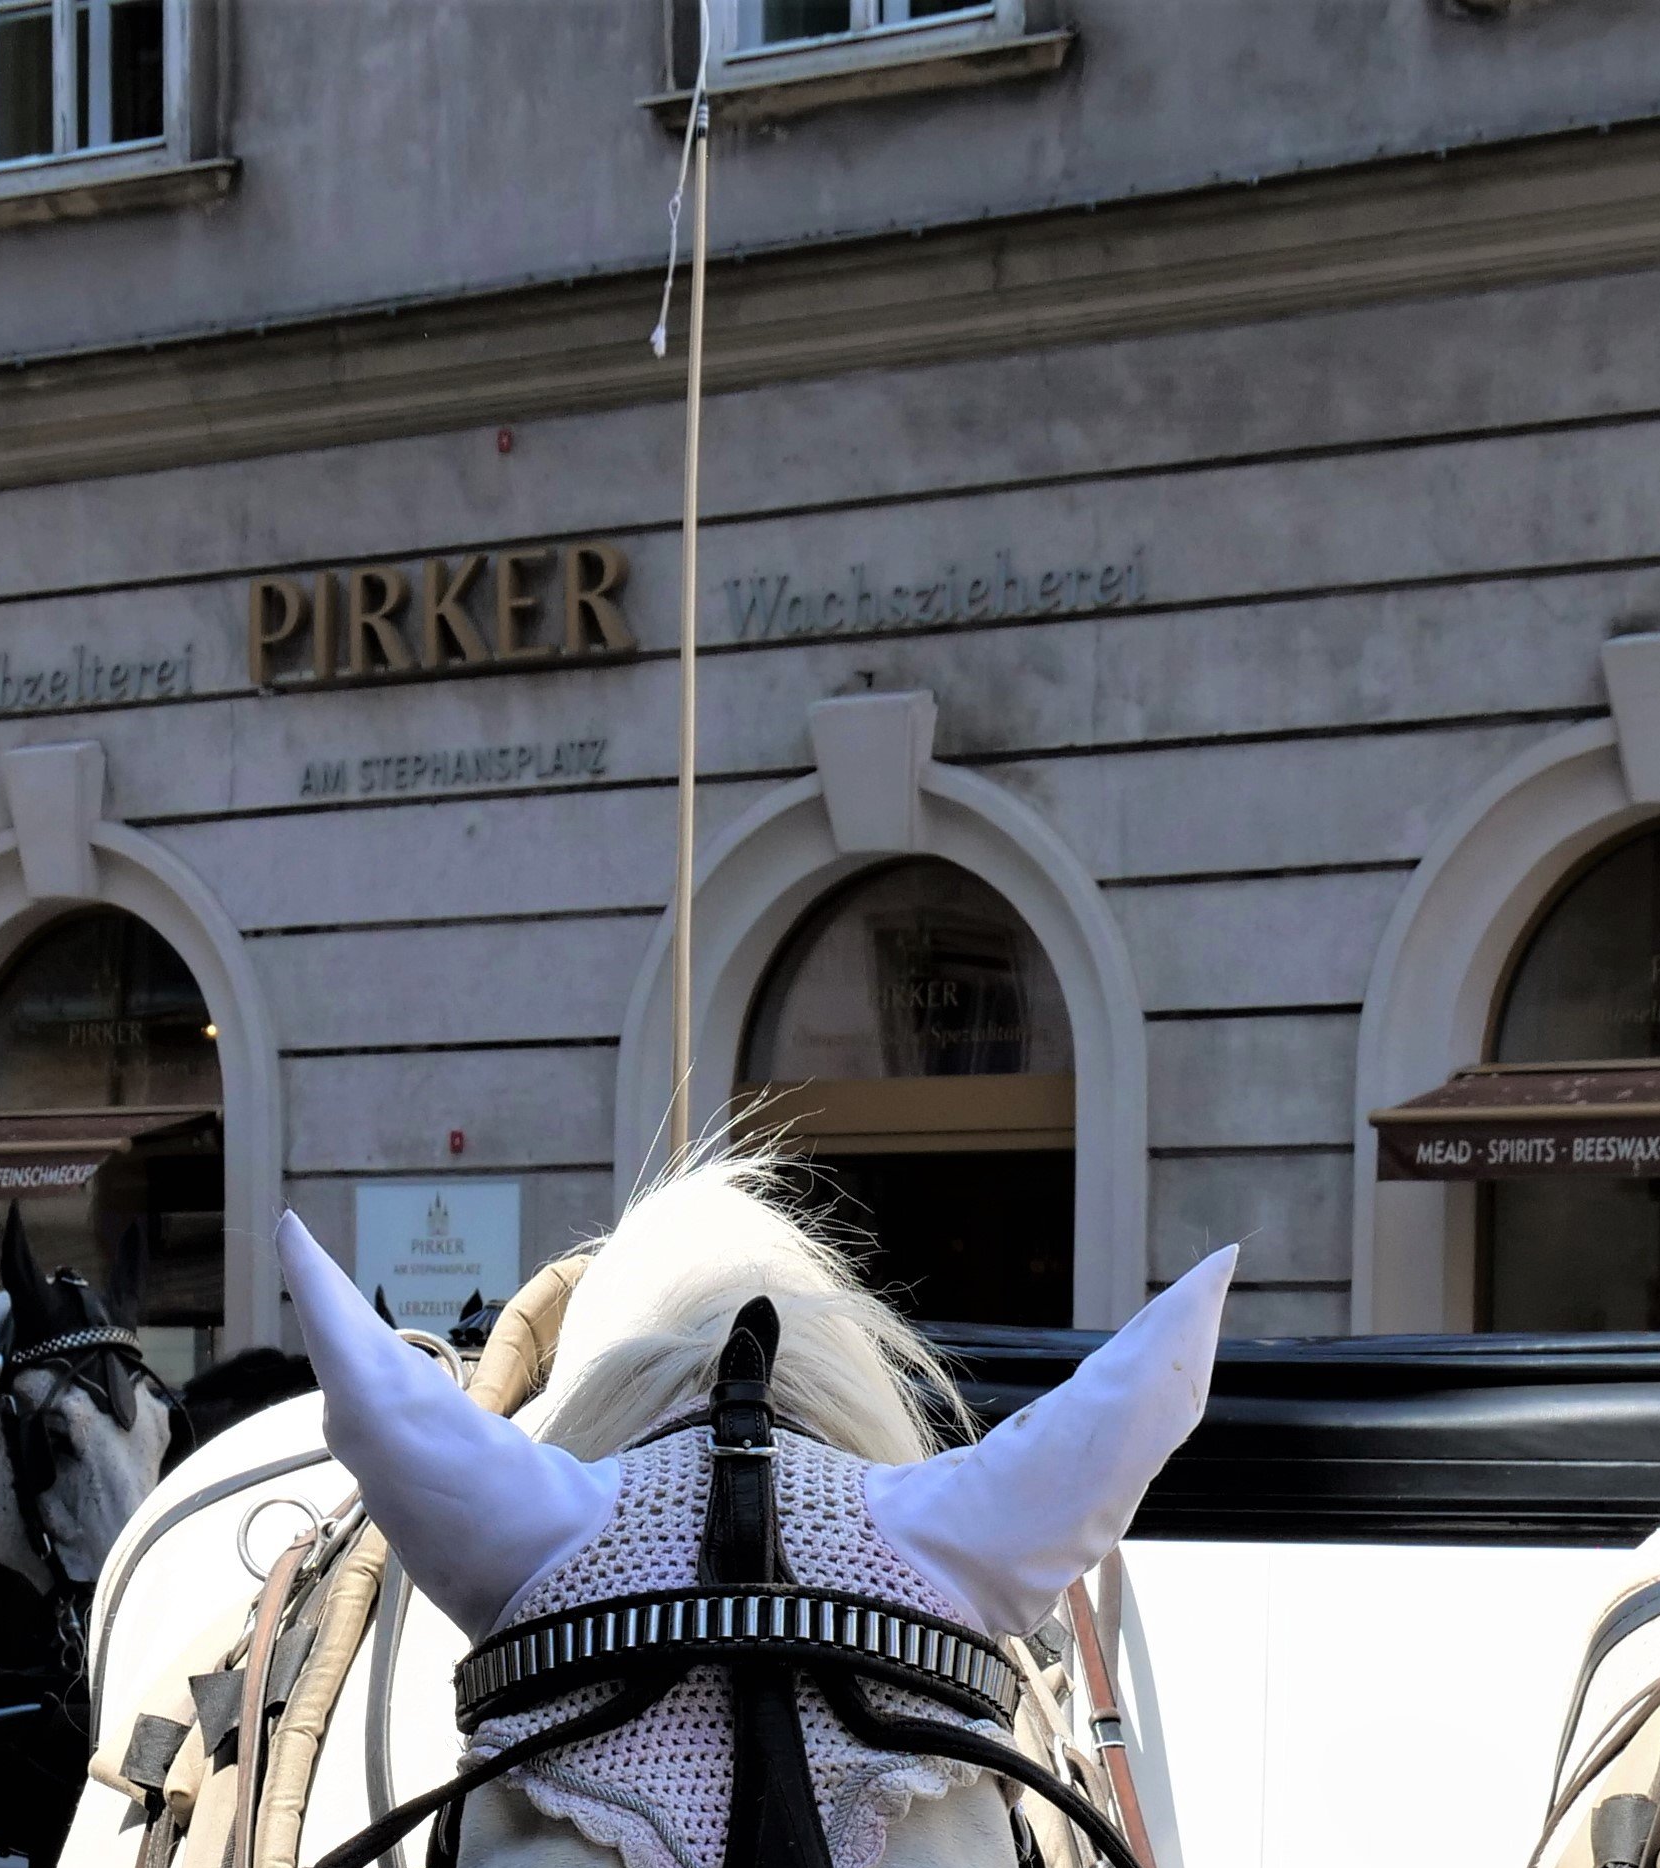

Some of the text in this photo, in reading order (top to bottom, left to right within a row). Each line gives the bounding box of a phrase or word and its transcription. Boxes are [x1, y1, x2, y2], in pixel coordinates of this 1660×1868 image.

[250, 540, 638, 685] PIRKER
[723, 544, 1146, 639] Wachszieherei
[300, 739, 609, 797] AM STEPHANSPLATZ
[68, 1022, 144, 1046] PIRKER
[1415, 1139, 1470, 1165] MEAD
[1486, 1138, 1556, 1164] SPIRITS
[411, 1238, 465, 1255] PIRKER
